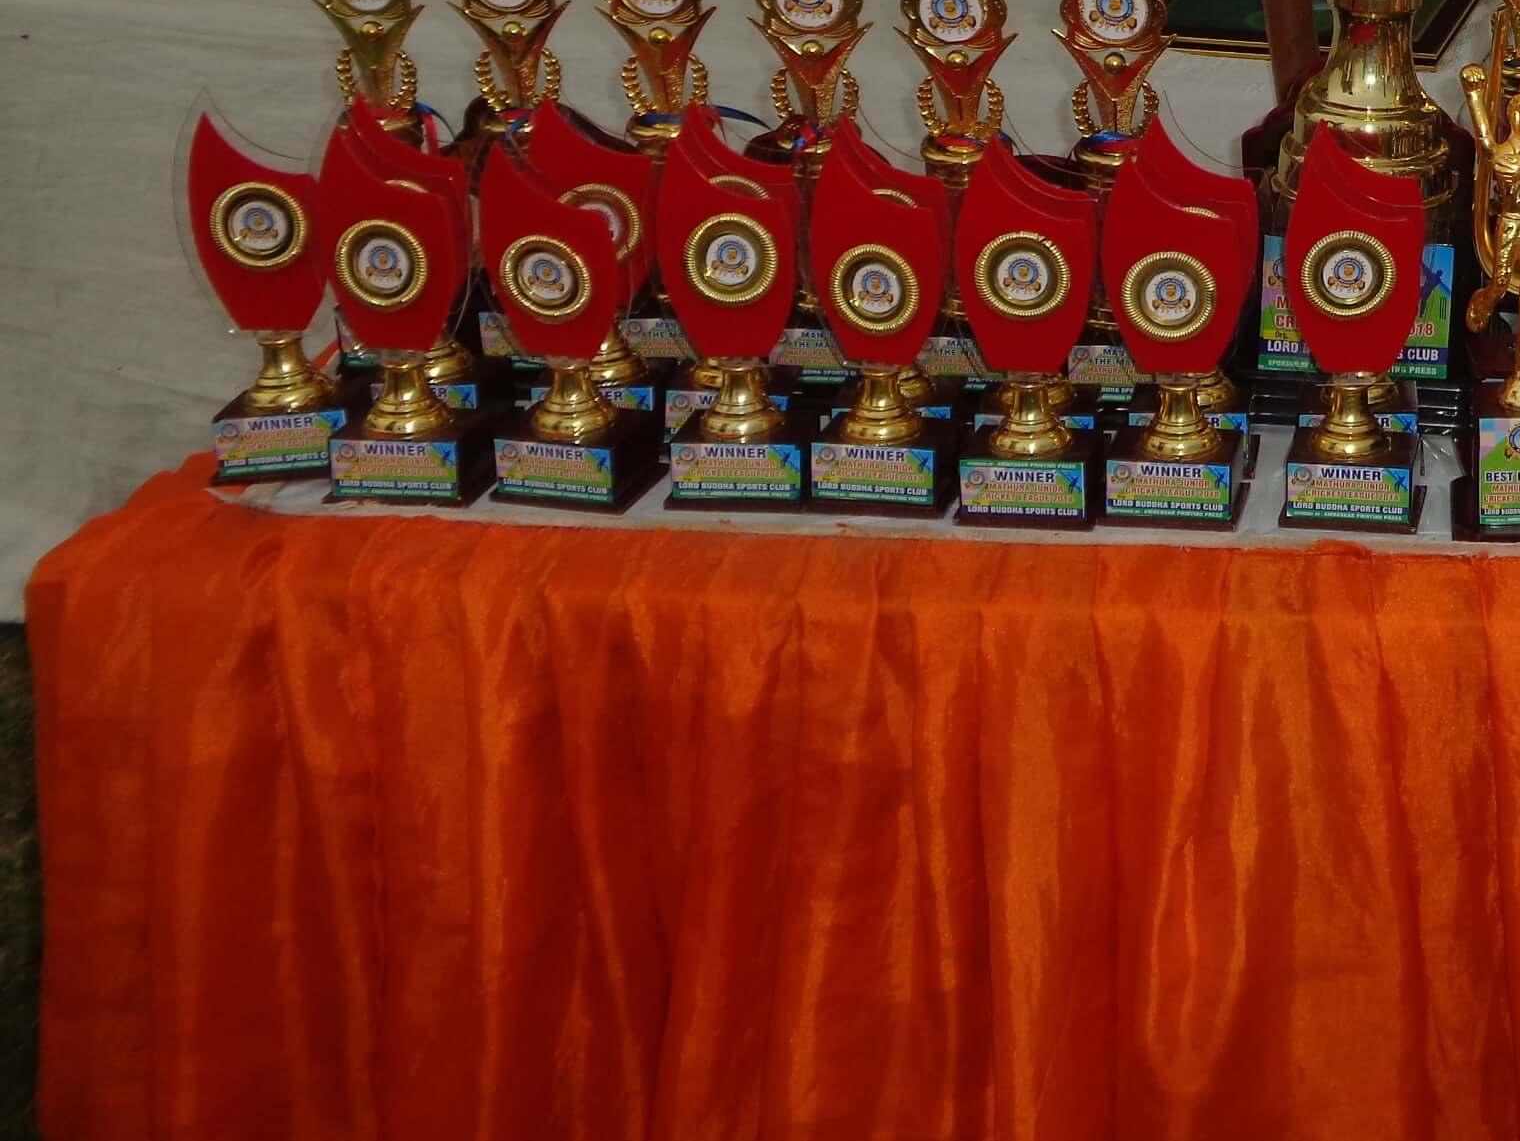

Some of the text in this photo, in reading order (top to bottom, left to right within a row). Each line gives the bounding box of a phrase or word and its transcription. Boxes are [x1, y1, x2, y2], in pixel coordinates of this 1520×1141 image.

[1267, 340, 1299, 354] LORD
[1406, 347, 1440, 362] CLUB
[247, 417, 314, 431] WINNER
[366, 443, 427, 456] WINNER
[526, 445, 584, 460] WINNER
[705, 447, 767, 459] WINNER
[846, 448, 905, 462] WINNER
[994, 470, 1055, 482] WINNER
[1141, 465, 1202, 478] WINNER
[1321, 467, 1381, 480] WINNER
[1486, 471, 1512, 481] BEST
[1113, 499, 1133, 507] LORD
[1170, 502, 1201, 510] SPORTS
[1202, 503, 1224, 511] CLUB
[1293, 501, 1313, 509] LORD
[1350, 504, 1380, 513] SPORTS
[1382, 506, 1403, 514] CLUB
